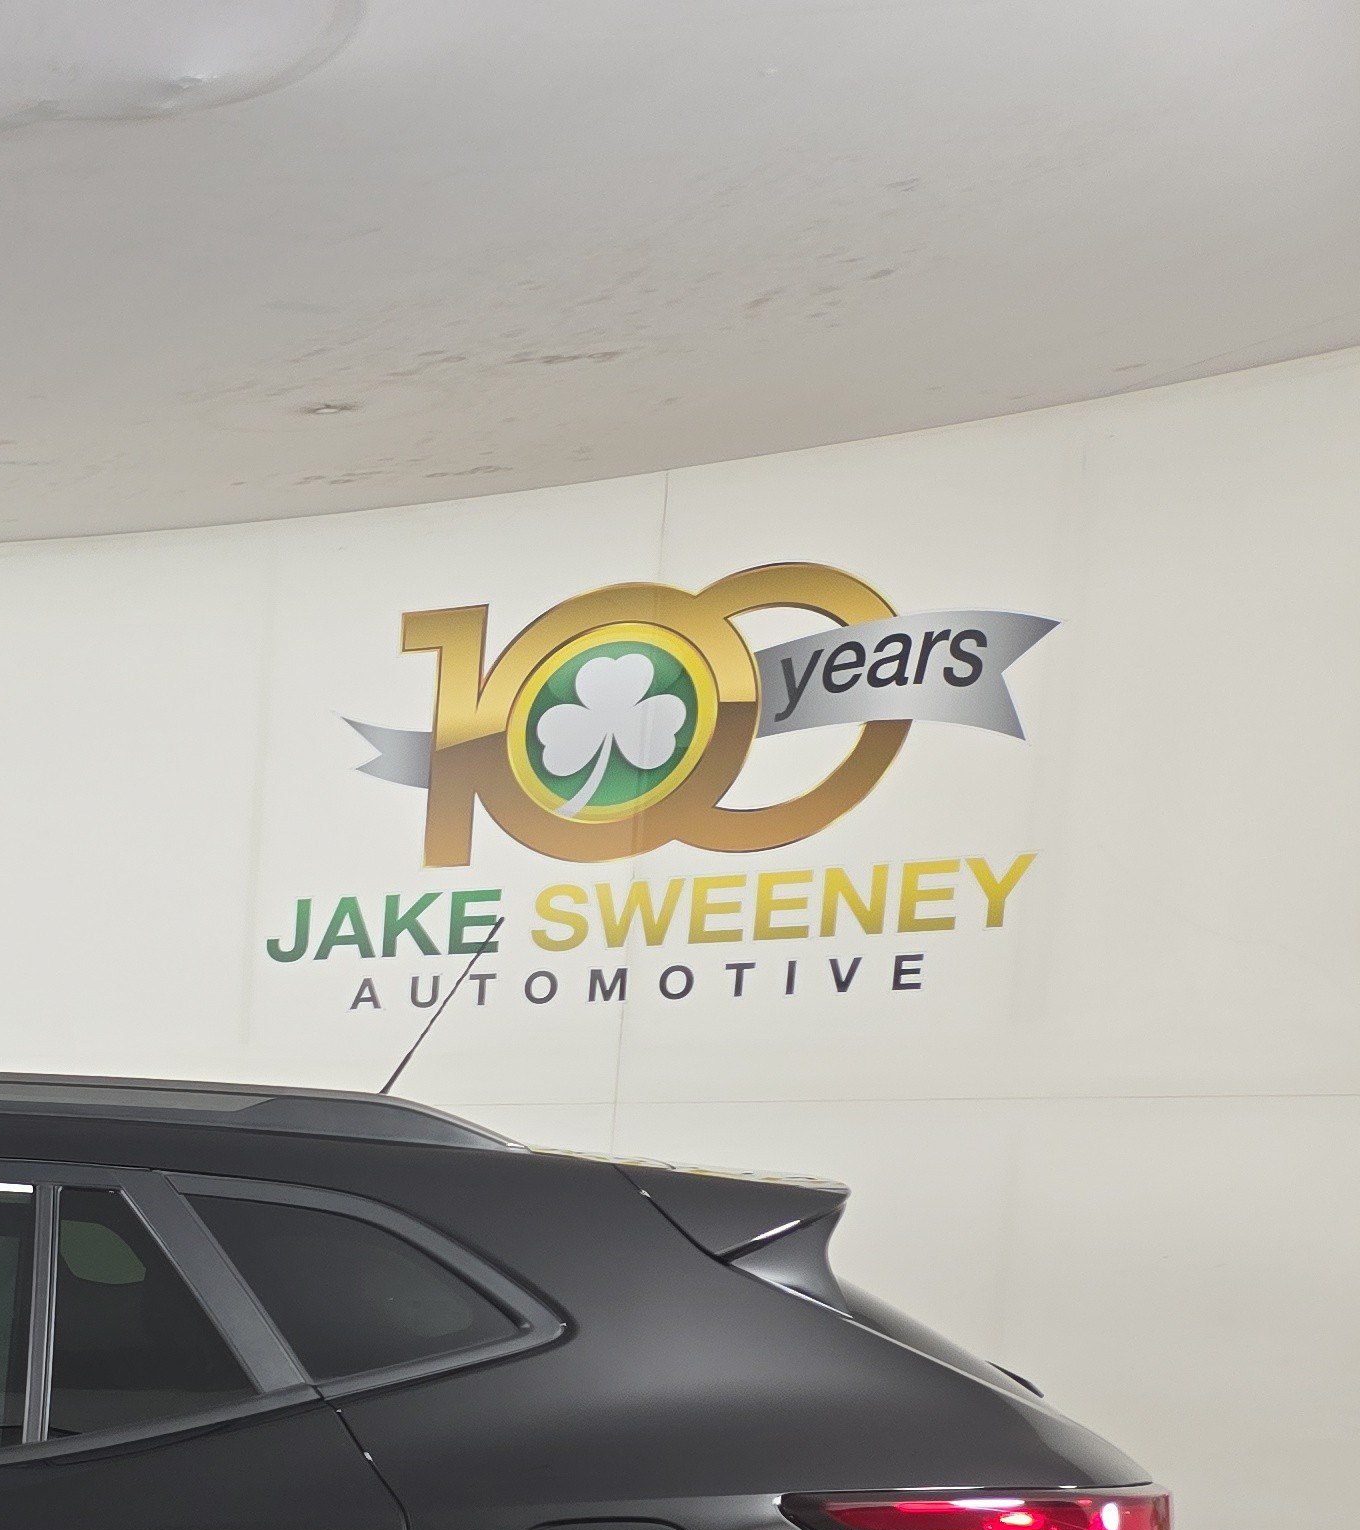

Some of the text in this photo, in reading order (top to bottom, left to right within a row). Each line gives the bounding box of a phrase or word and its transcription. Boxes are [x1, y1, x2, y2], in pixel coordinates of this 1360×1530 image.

[401, 562, 912, 868] 100
[774, 627, 988, 720] years
[266, 853, 1037, 962] JAKE SWEENEY
[349, 954, 925, 1010] AUTOMOTIVE
